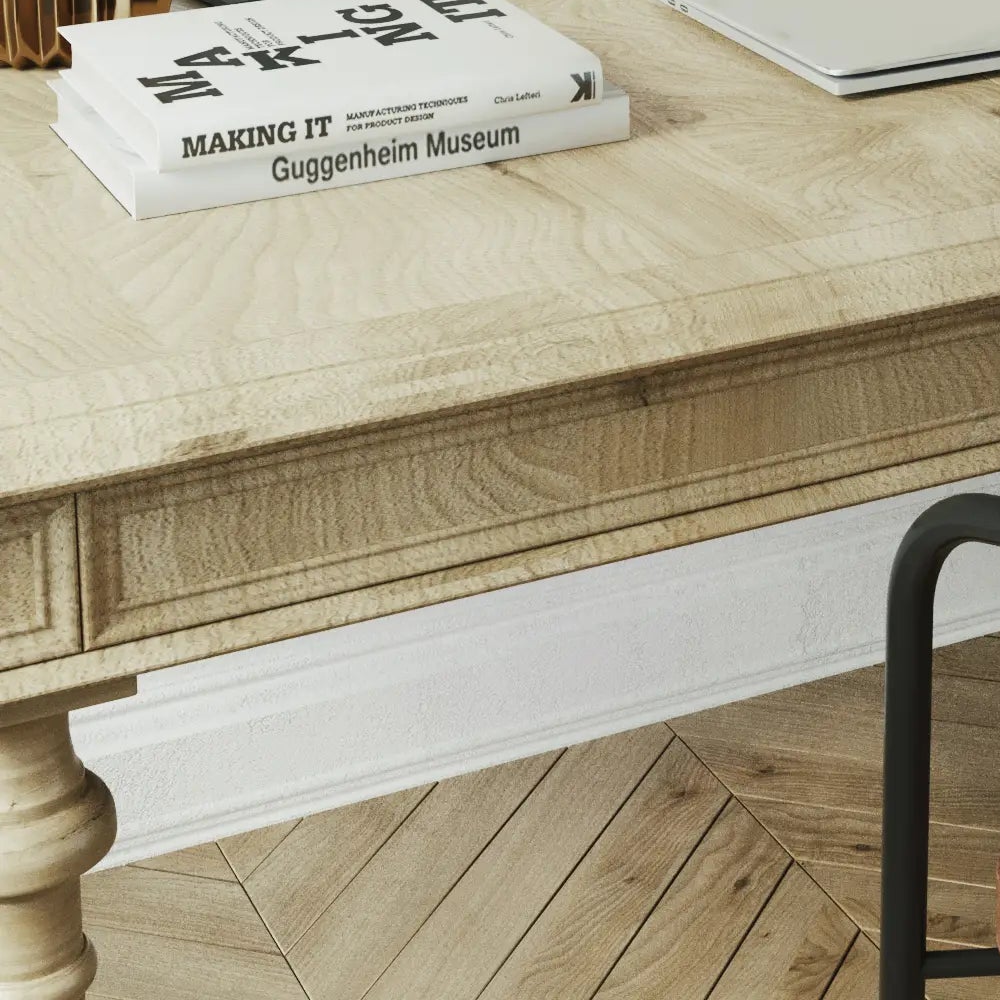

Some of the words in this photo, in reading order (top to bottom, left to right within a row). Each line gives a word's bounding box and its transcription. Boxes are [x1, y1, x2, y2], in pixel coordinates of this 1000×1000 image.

[346, 102, 417, 121] MANUFACTURING
[418, 95, 468, 111] TECHNIQUES
[346, 123, 363, 132] FOR
[364, 117, 402, 130] PRODUCT
[404, 112, 435, 125] DESIGN
[181, 120, 297, 158] MAKING
[304, 115, 332, 139] IT
[272, 138, 418, 184] Guggenheim
[426, 125, 520, 157] Museum
